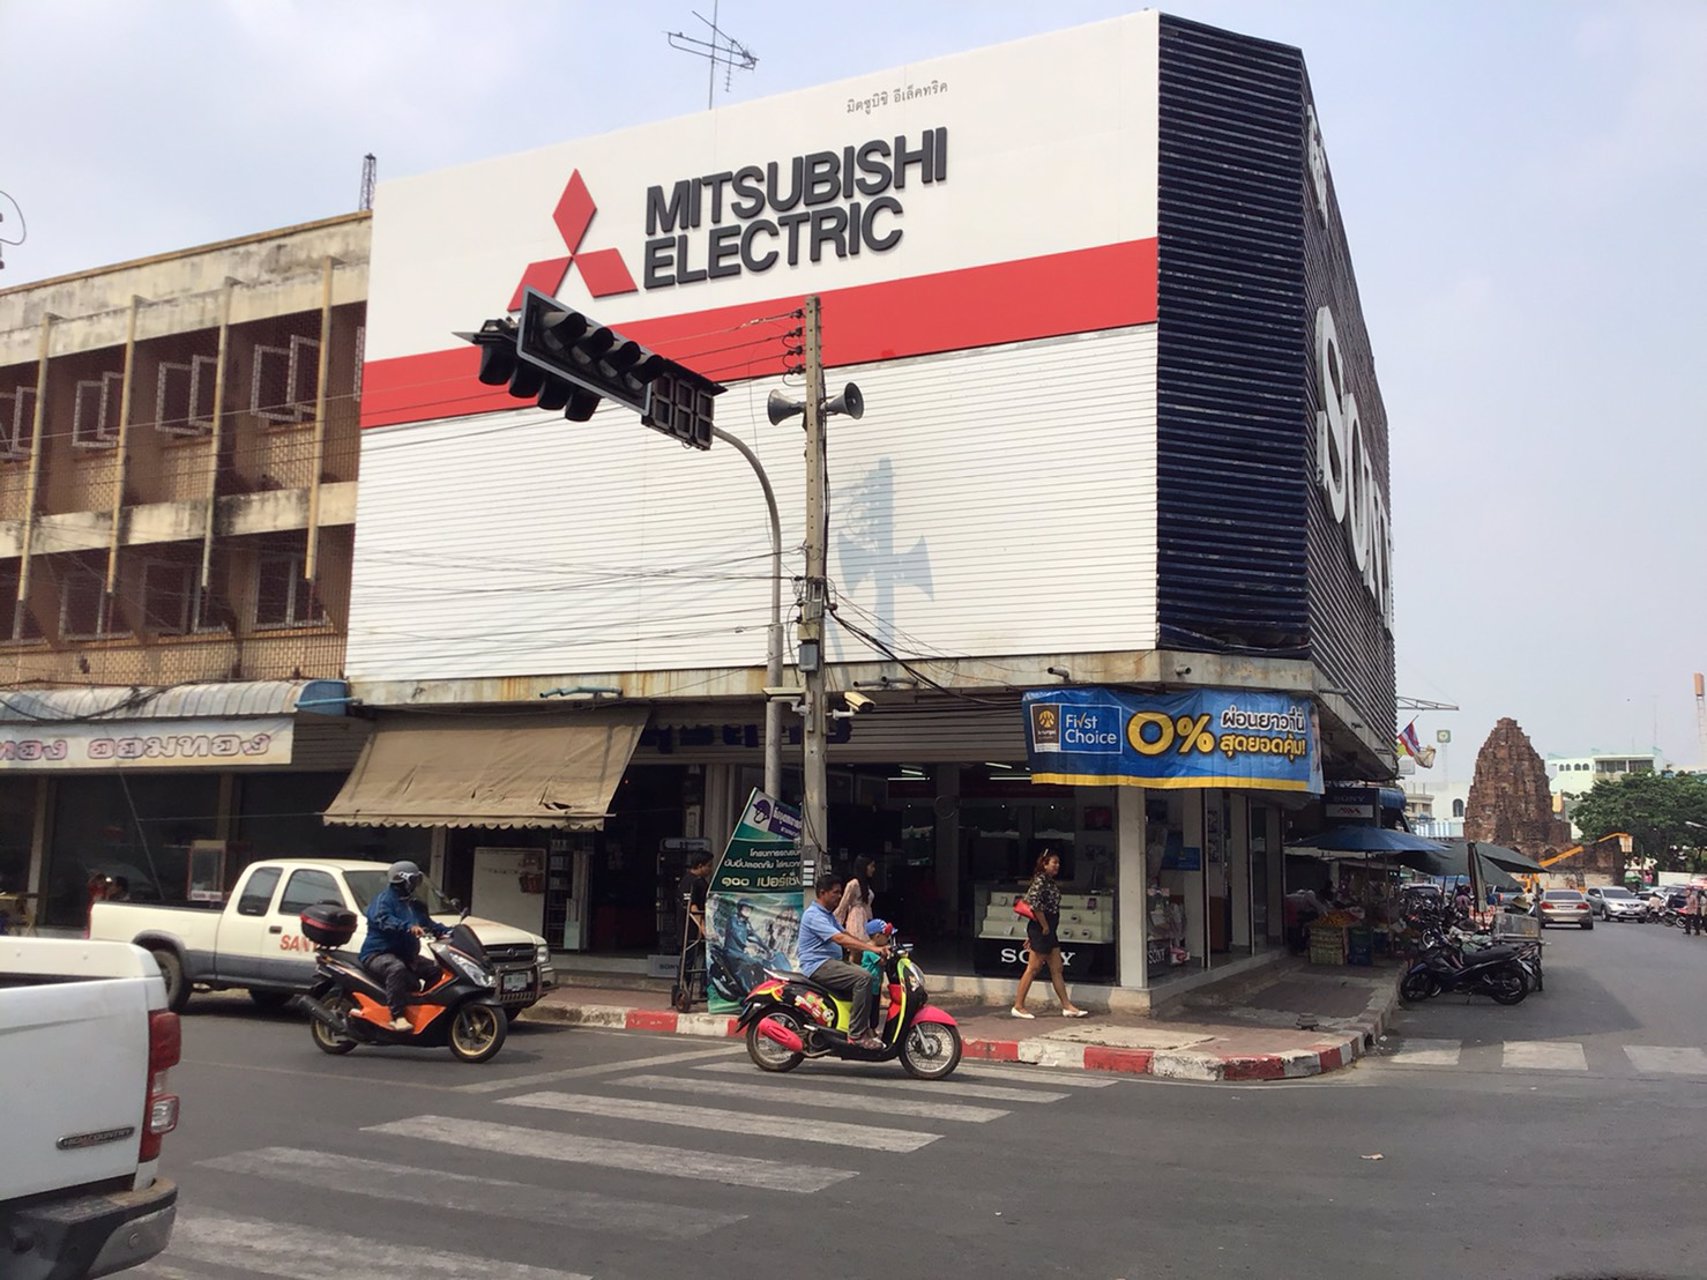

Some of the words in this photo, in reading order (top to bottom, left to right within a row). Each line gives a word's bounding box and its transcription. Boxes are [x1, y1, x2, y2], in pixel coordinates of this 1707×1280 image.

[646, 126, 948, 235] MITSUBISHI
[643, 196, 903, 290] ELECTRIC
[1066, 712, 1098, 729] First
[1127, 710, 1216, 756] 0%
[87, 732, 272, 760] ออมทอง
[1065, 728, 1117, 744] Choice
[1001, 947, 1076, 966] SOY
